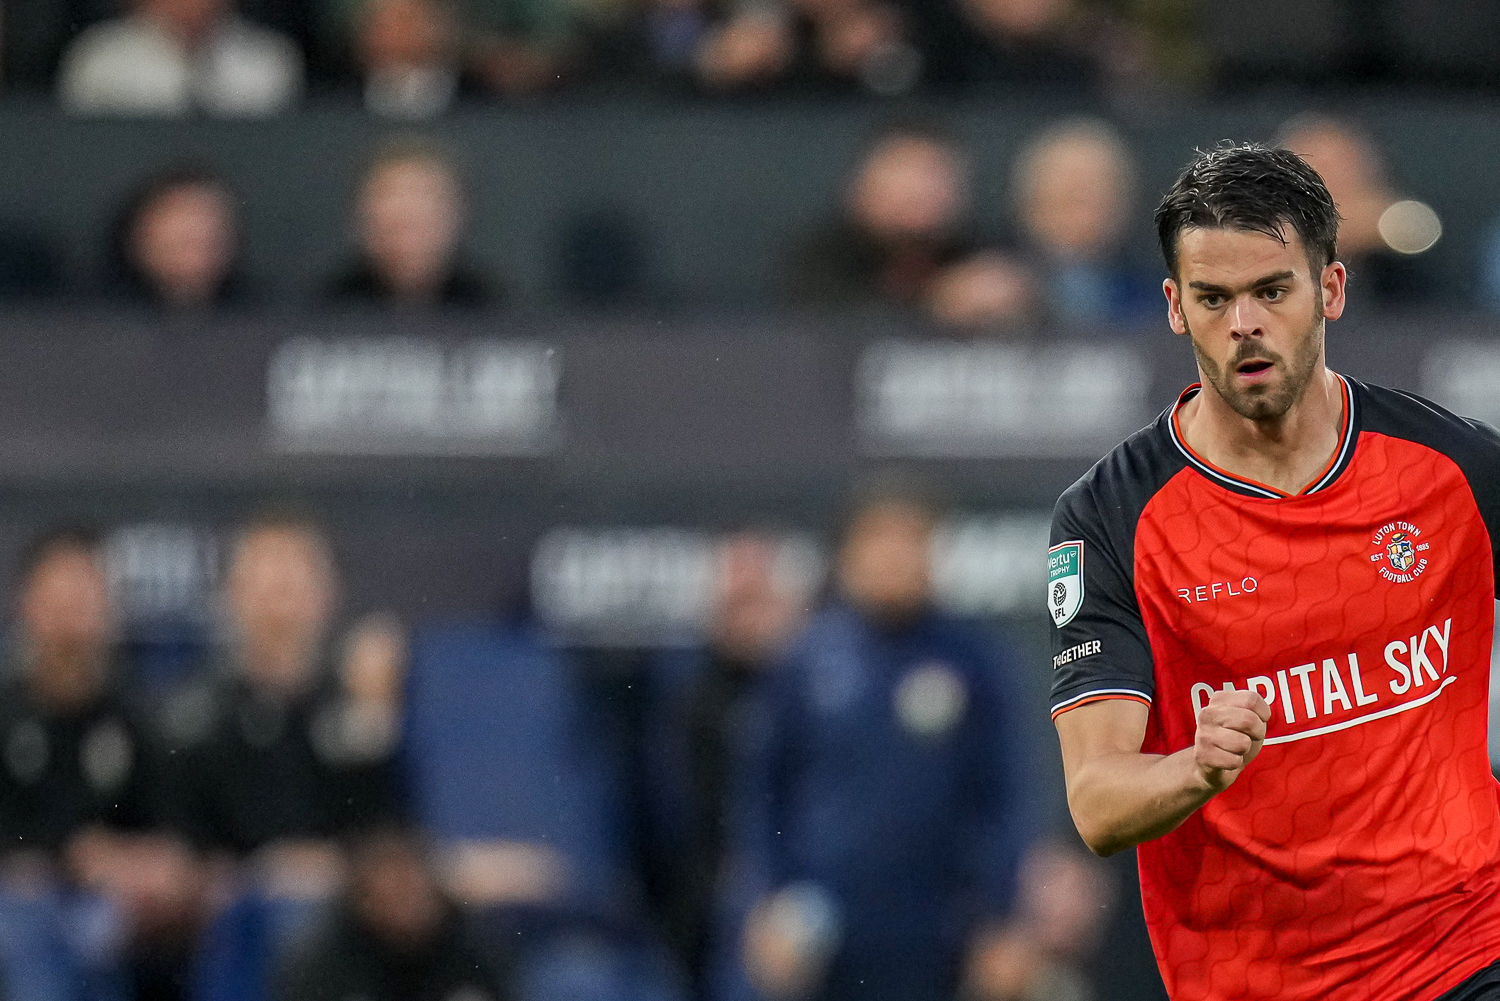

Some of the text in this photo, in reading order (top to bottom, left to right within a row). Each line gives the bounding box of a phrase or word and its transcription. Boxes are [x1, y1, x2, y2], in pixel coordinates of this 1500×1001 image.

[1372, 521, 1422, 546] LUTON TOWN
[1047, 552, 1070, 570] Vertu
[1370, 552, 1384, 562] EST
[1050, 565, 1070, 578] TROPHY
[1378, 558, 1428, 584] FOOTBALL CLUB
[1177, 576, 1258, 604] REFLO
[1055, 607, 1066, 619] EFL
[1190, 652, 1379, 726] CPITAL
[1384, 618, 1452, 695] SKY
